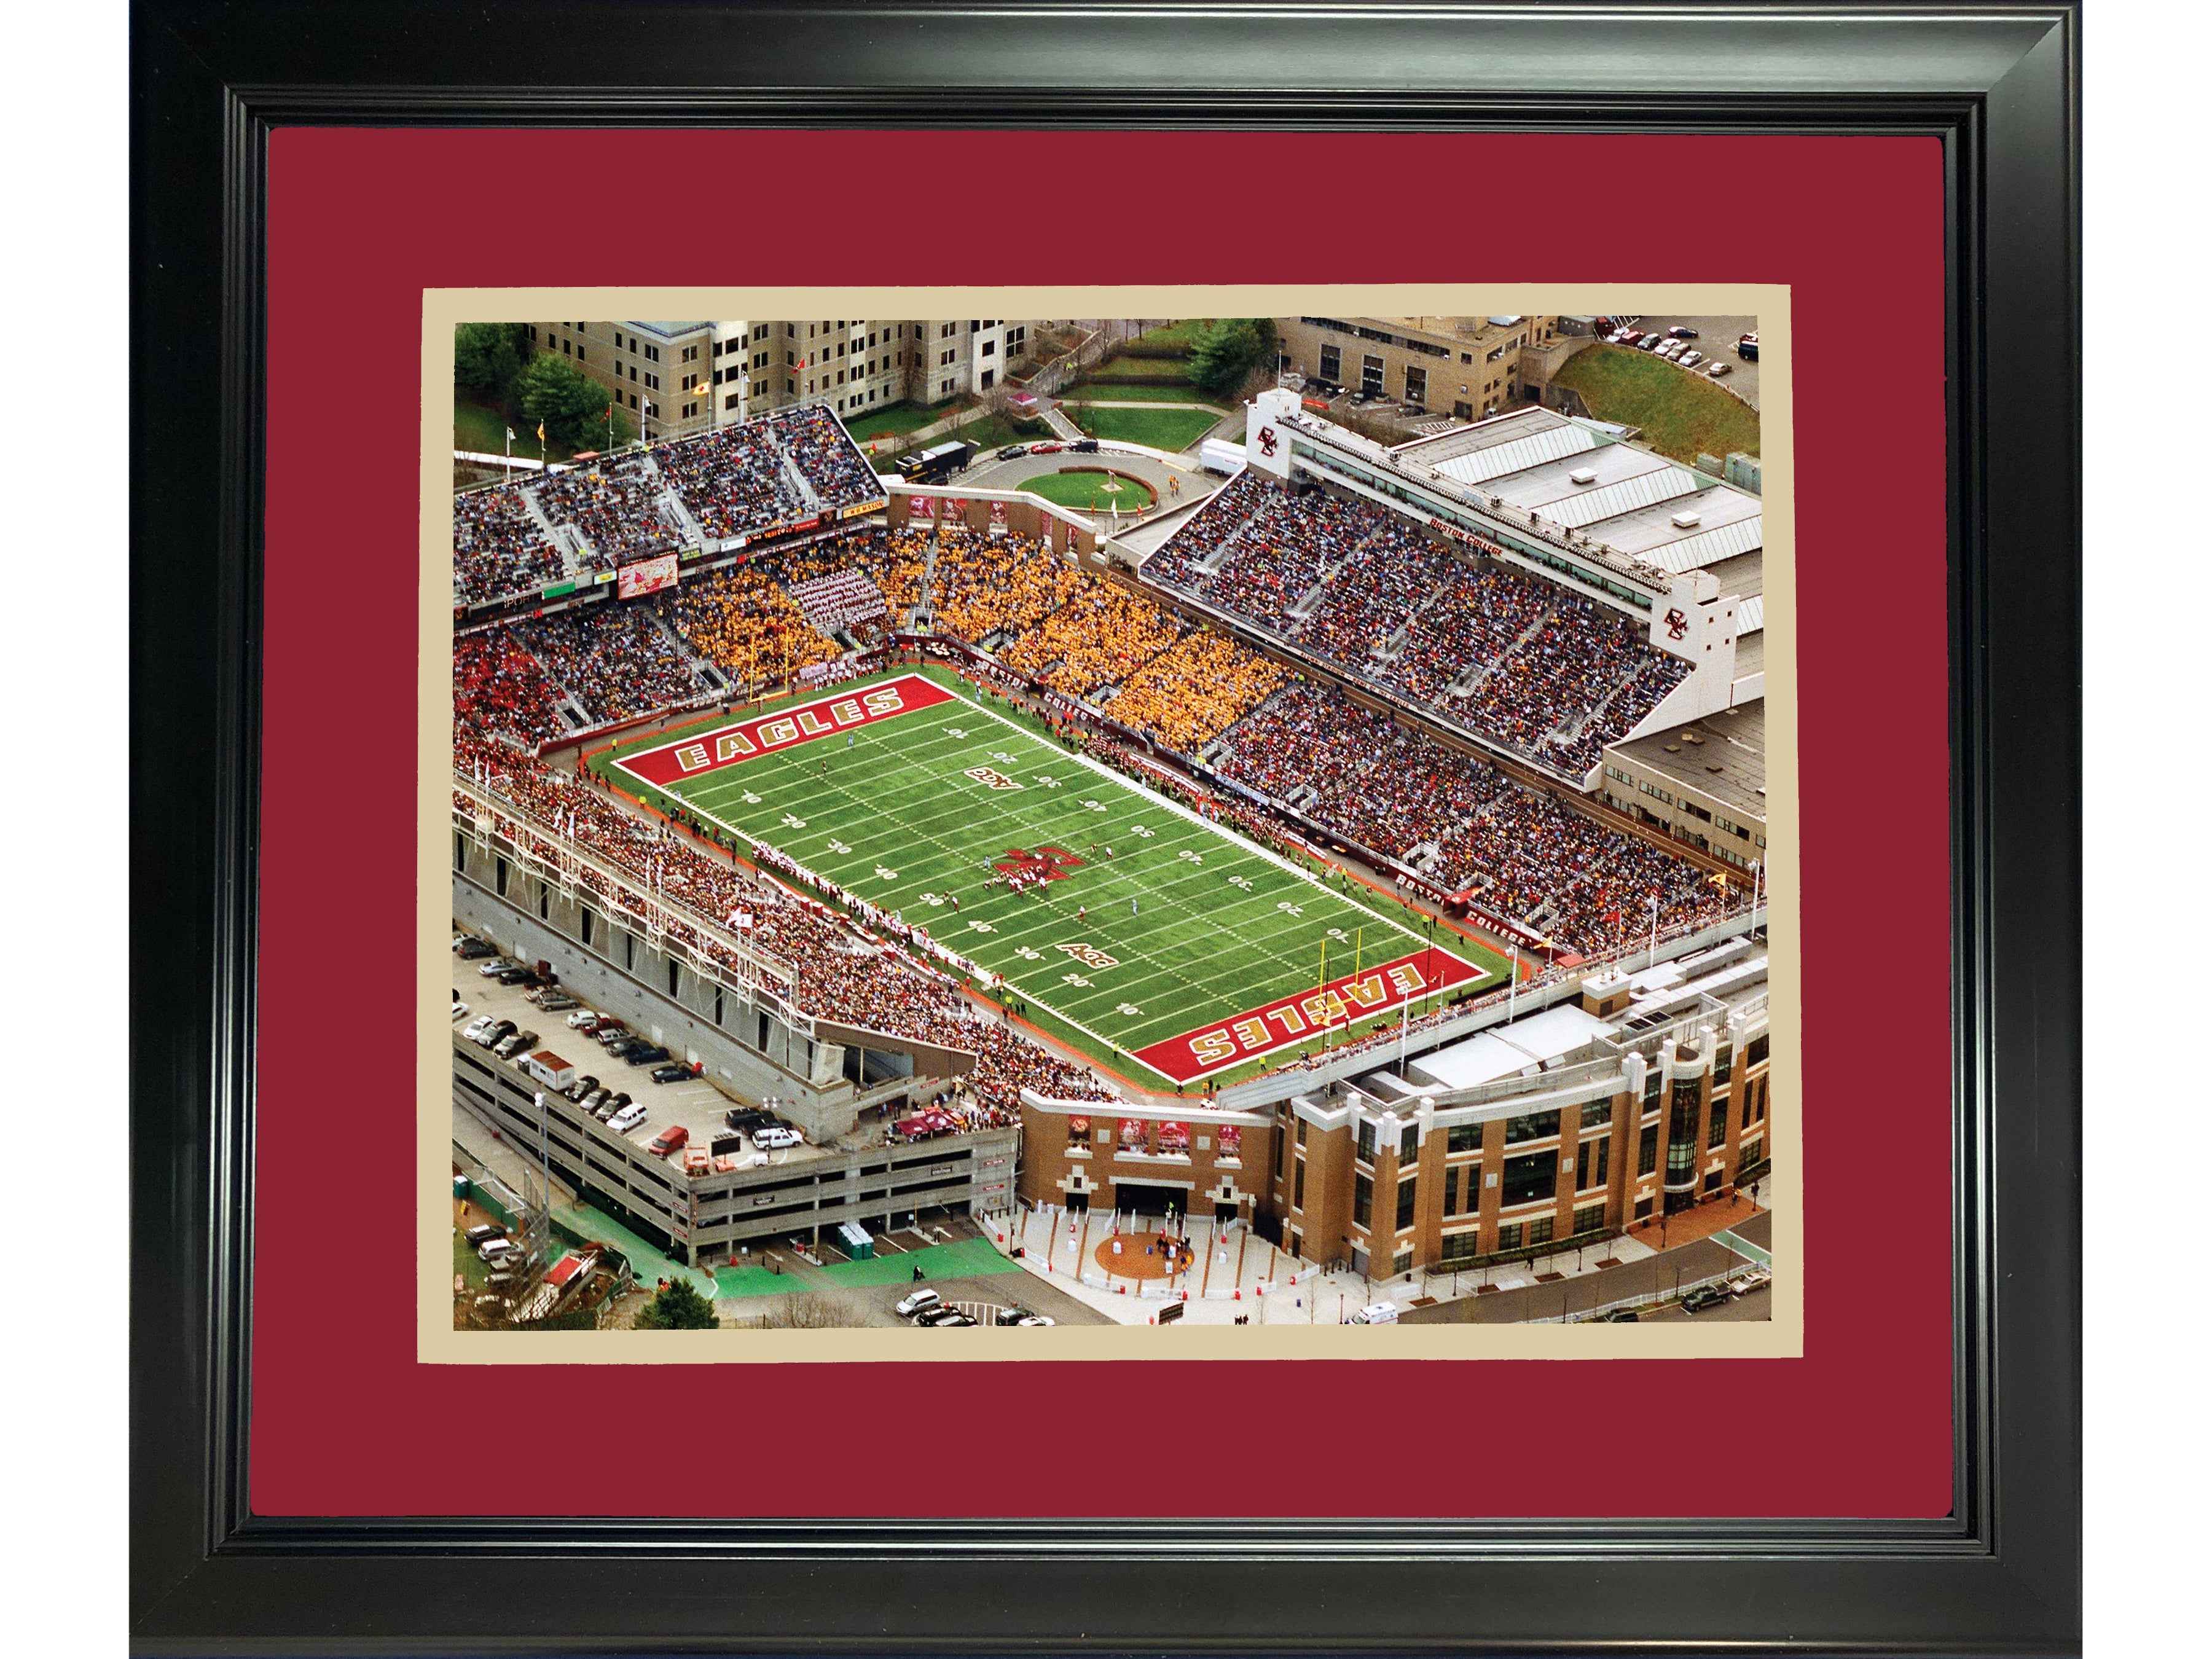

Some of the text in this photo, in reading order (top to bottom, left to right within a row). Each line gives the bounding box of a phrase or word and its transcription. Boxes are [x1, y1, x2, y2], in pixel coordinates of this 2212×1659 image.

[1430, 518, 1503, 556] BOSTON COLLEGE
[674, 687, 904, 772] EAGLES
[1467, 911, 1526, 946] COLLEGE
[1188, 962, 1427, 1066] EAGLES
